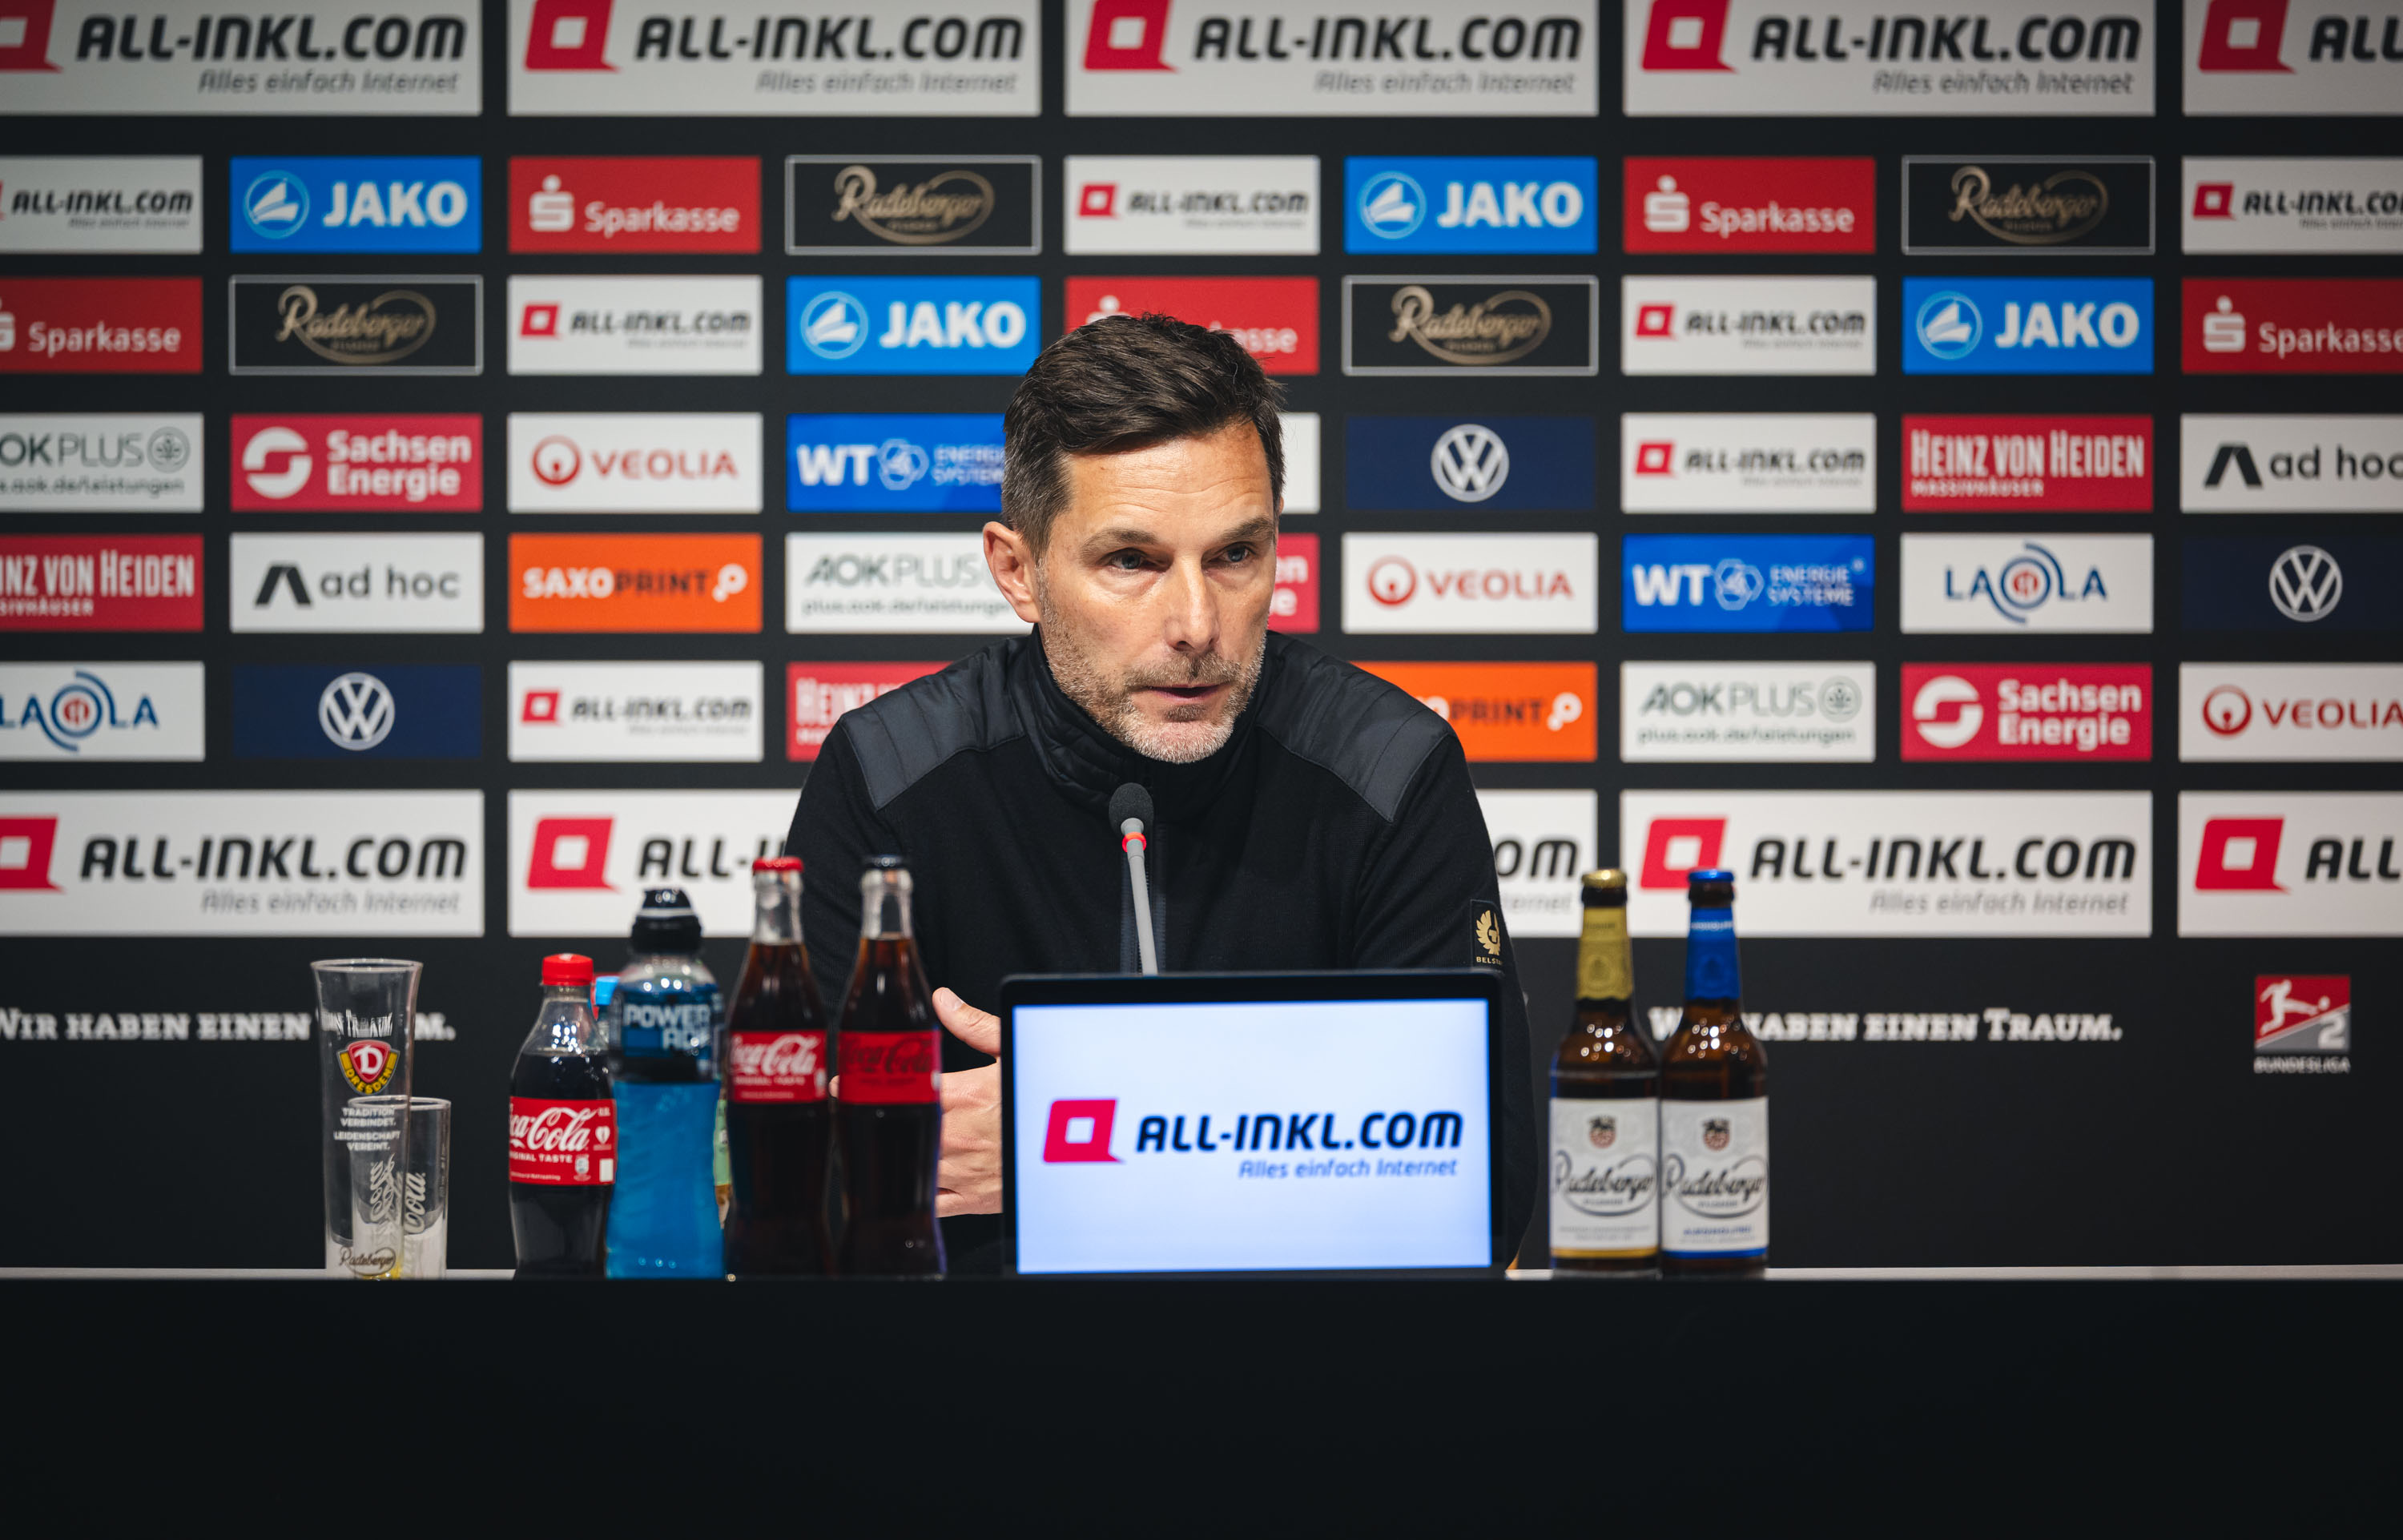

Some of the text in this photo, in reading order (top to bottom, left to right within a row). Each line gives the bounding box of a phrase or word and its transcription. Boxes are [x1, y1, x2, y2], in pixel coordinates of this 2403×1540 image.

[75, 14, 466, 62] ALL-INKL.COM
[635, 16, 1024, 60] ALL-INKL.COM
[1194, 16, 1583, 60] ALL-INKL.COM
[1753, 15, 2142, 62] ALL-INKL.COM
[199, 69, 458, 93] Alles einfach Internet
[756, 70, 1017, 93] Alles einfach Internet
[1314, 70, 1576, 94] Alles einfach Internet
[1873, 70, 2134, 94] Alles einfach Internet
[11, 191, 192, 214] ALL-INKL.COM
[324, 182, 468, 227] JAKO
[586, 202, 740, 237] Sparkasse
[1128, 192, 1309, 213] ALL-INKL.COM
[1437, 182, 1583, 227] JAKO
[1701, 202, 1854, 238] Sparkasse
[30, 322, 181, 357] Sparkasse
[275, 286, 432, 358] Radeberger
[570, 312, 751, 333] ALL-INKL.COM
[879, 301, 1026, 348] JAKO
[1686, 312, 1866, 334] ALL-INKL.COM
[1995, 303, 2139, 348] JAKO
[328, 429, 472, 464] Sachsen
[591, 450, 737, 478] VEOLIA
[1685, 450, 1866, 471] ALL-INKL.COM
[1911, 430, 2143, 477] HEINZ VON HEIDEN
[2269, 444, 2322, 480] ad
[328, 461, 461, 501] Energie
[797, 444, 879, 485] WT
[44, 556, 94, 596] VON
[101, 550, 194, 597] HEIDEN
[320, 563, 460, 598] ad hoc
[521, 568, 708, 599] SAXOPRINT
[1427, 570, 1573, 599] VEOLIA
[1632, 565, 1713, 605] WT
[571, 698, 751, 720] ALL-INKL.COM
[1998, 679, 2142, 711] Sachsen
[1998, 713, 2131, 751] Energie
[79, 836, 466, 881] ALL-INKL.COM
[1751, 838, 2136, 881] ALL-INKL.COM
[200, 890, 459, 914] Alles einfach Internet
[1870, 891, 2129, 915] Alles einfach Internet
[1476, 956, 1503, 965] BELST
[66, 1014, 190, 1039] HABEN
[198, 1013, 311, 1039] EINEN
[622, 1003, 710, 1031] POWER
[1864, 1014, 1978, 1040] EINEN
[1983, 1008, 2122, 1040] TRAUM.
[346, 1068, 392, 1095] DRESDEN
[1137, 1112, 1463, 1152] ALL-INKL.COM
[538, 1153, 573, 1164] TASTE
[1239, 1159, 1457, 1178] Alles einfach Internet
